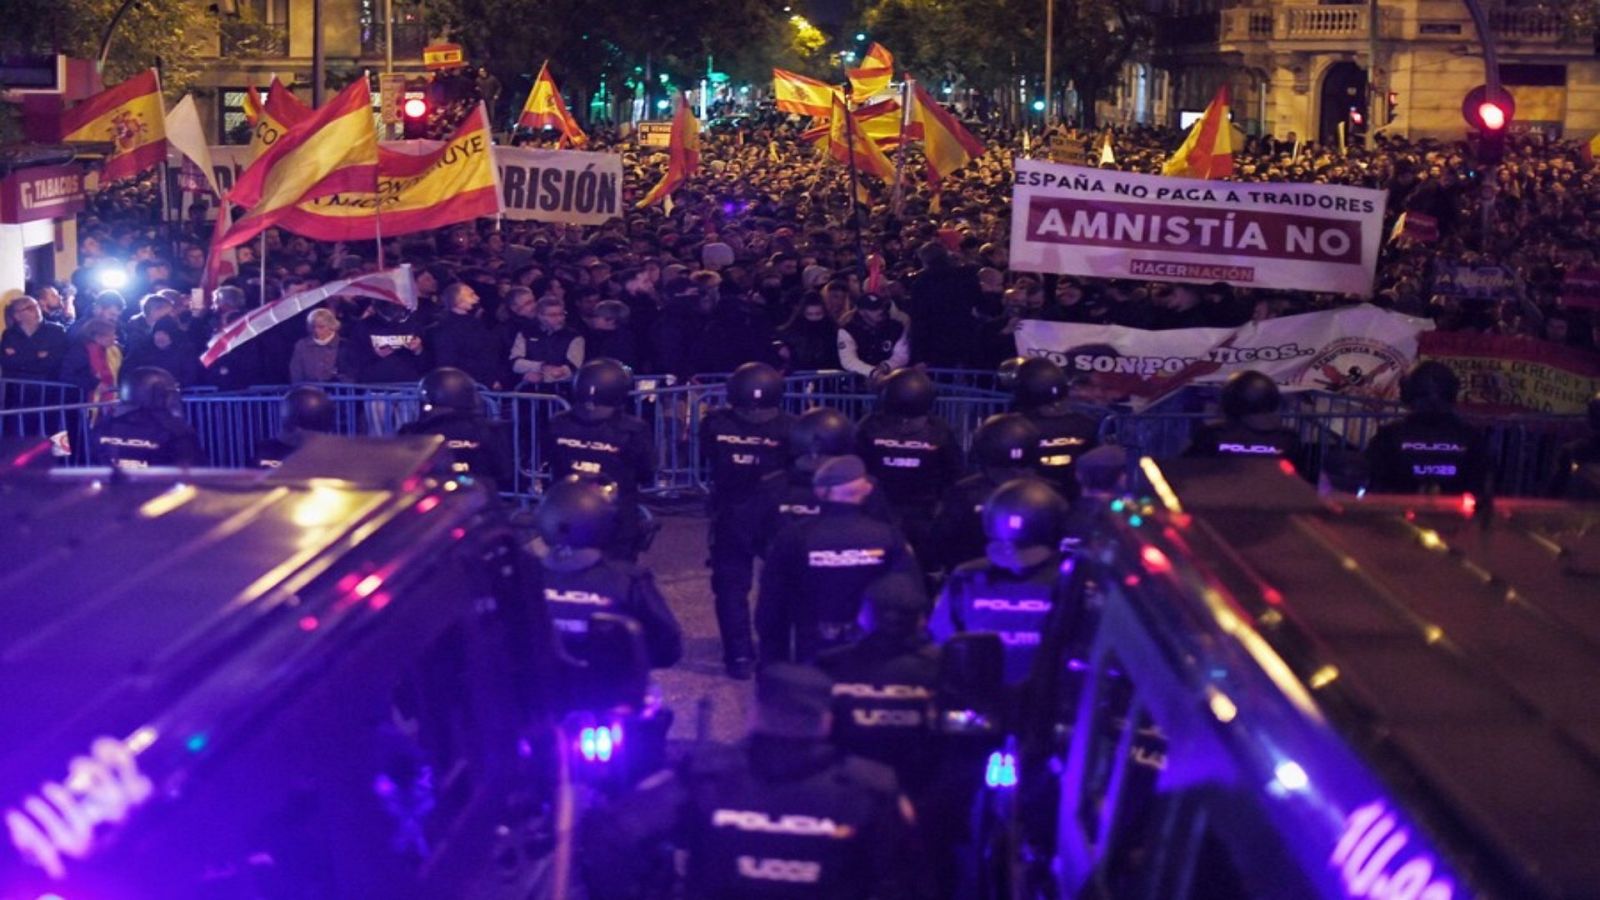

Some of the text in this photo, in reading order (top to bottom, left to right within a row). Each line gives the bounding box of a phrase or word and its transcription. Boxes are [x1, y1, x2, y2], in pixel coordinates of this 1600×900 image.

[34, 175, 79, 200] TABACOS
[499, 163, 617, 214] RISIÓN
[1015, 171, 1374, 213] ESPAÑA NO PAGA A TRAIDORES
[1036, 208, 1350, 256] AMNISTÍA NO
[1132, 261, 1251, 280] HACERNACIÓN
[1075, 354, 1139, 375] SON
[713, 809, 836, 836] POLICIA
